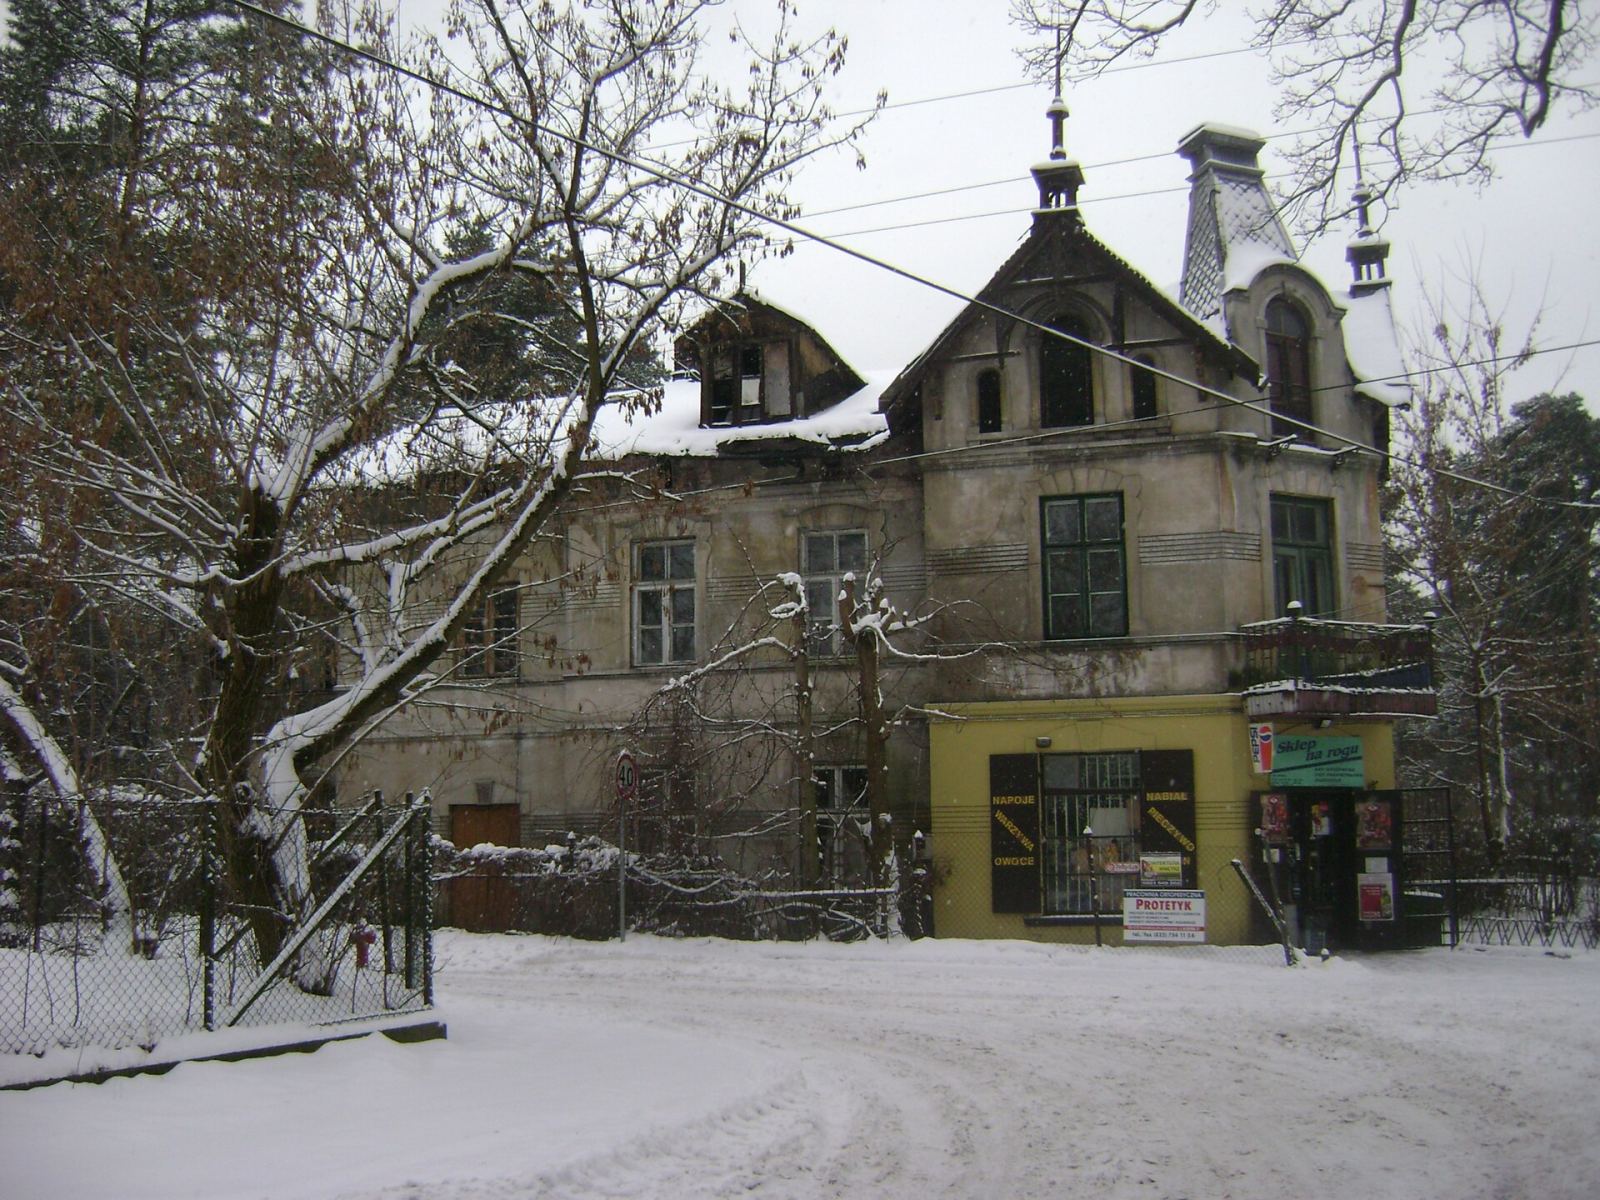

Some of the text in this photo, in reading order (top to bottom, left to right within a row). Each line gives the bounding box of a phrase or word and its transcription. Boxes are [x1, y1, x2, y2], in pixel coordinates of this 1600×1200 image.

[1250, 727, 1260, 763] PEPSI
[1277, 740, 1317, 754] Sklep
[1305, 745, 1359, 761] na rogu
[620, 765, 634, 787] 40
[992, 795, 1035, 805] NAPOJE
[994, 809, 1035, 852] WARZYWA
[1147, 806, 1195, 852] PIECZYWO
[994, 856, 1035, 866] OWOCE
[1135, 899, 1192, 911] PROTETYK
